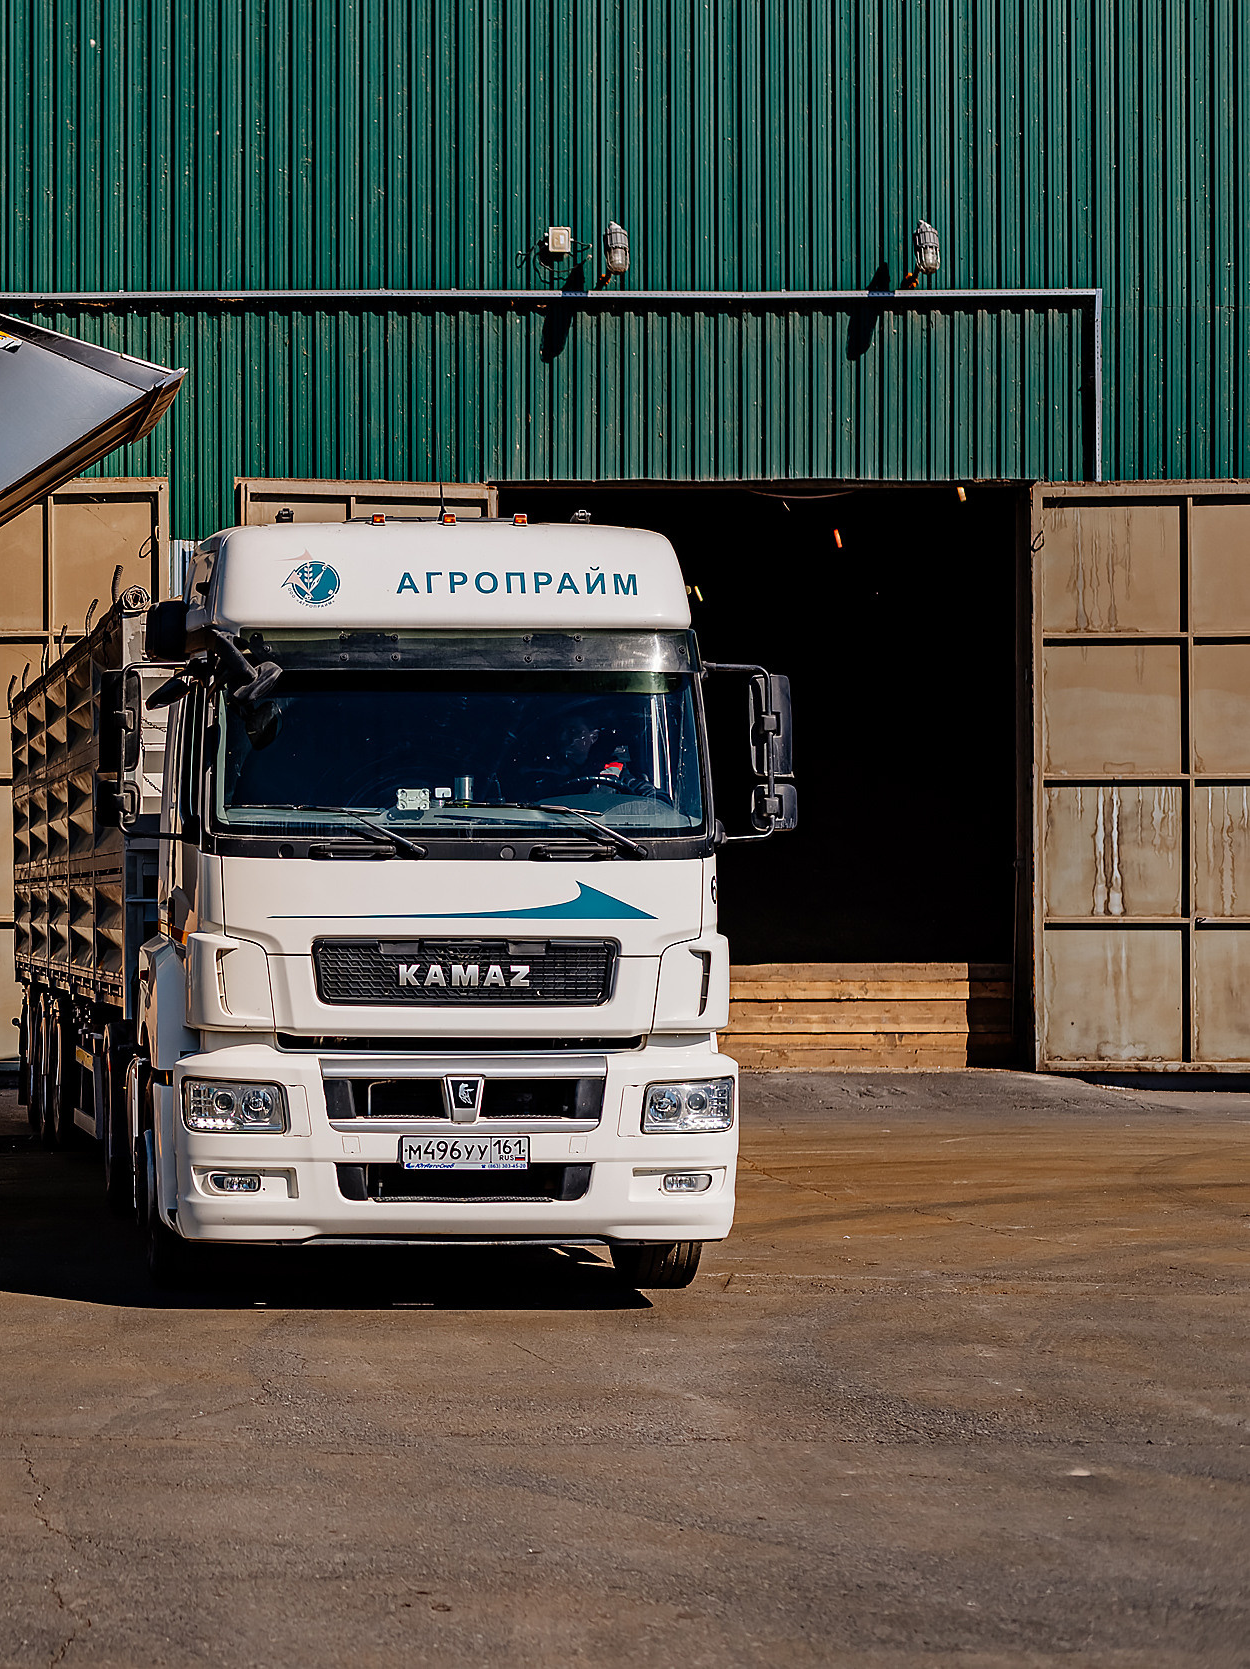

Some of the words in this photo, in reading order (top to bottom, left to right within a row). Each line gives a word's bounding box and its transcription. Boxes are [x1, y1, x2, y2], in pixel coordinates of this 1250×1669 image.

[396, 566, 639, 596] АГРОПРАЙМ
[398, 964, 530, 986] KAMAZ
[492, 1139, 522, 1155] 161
